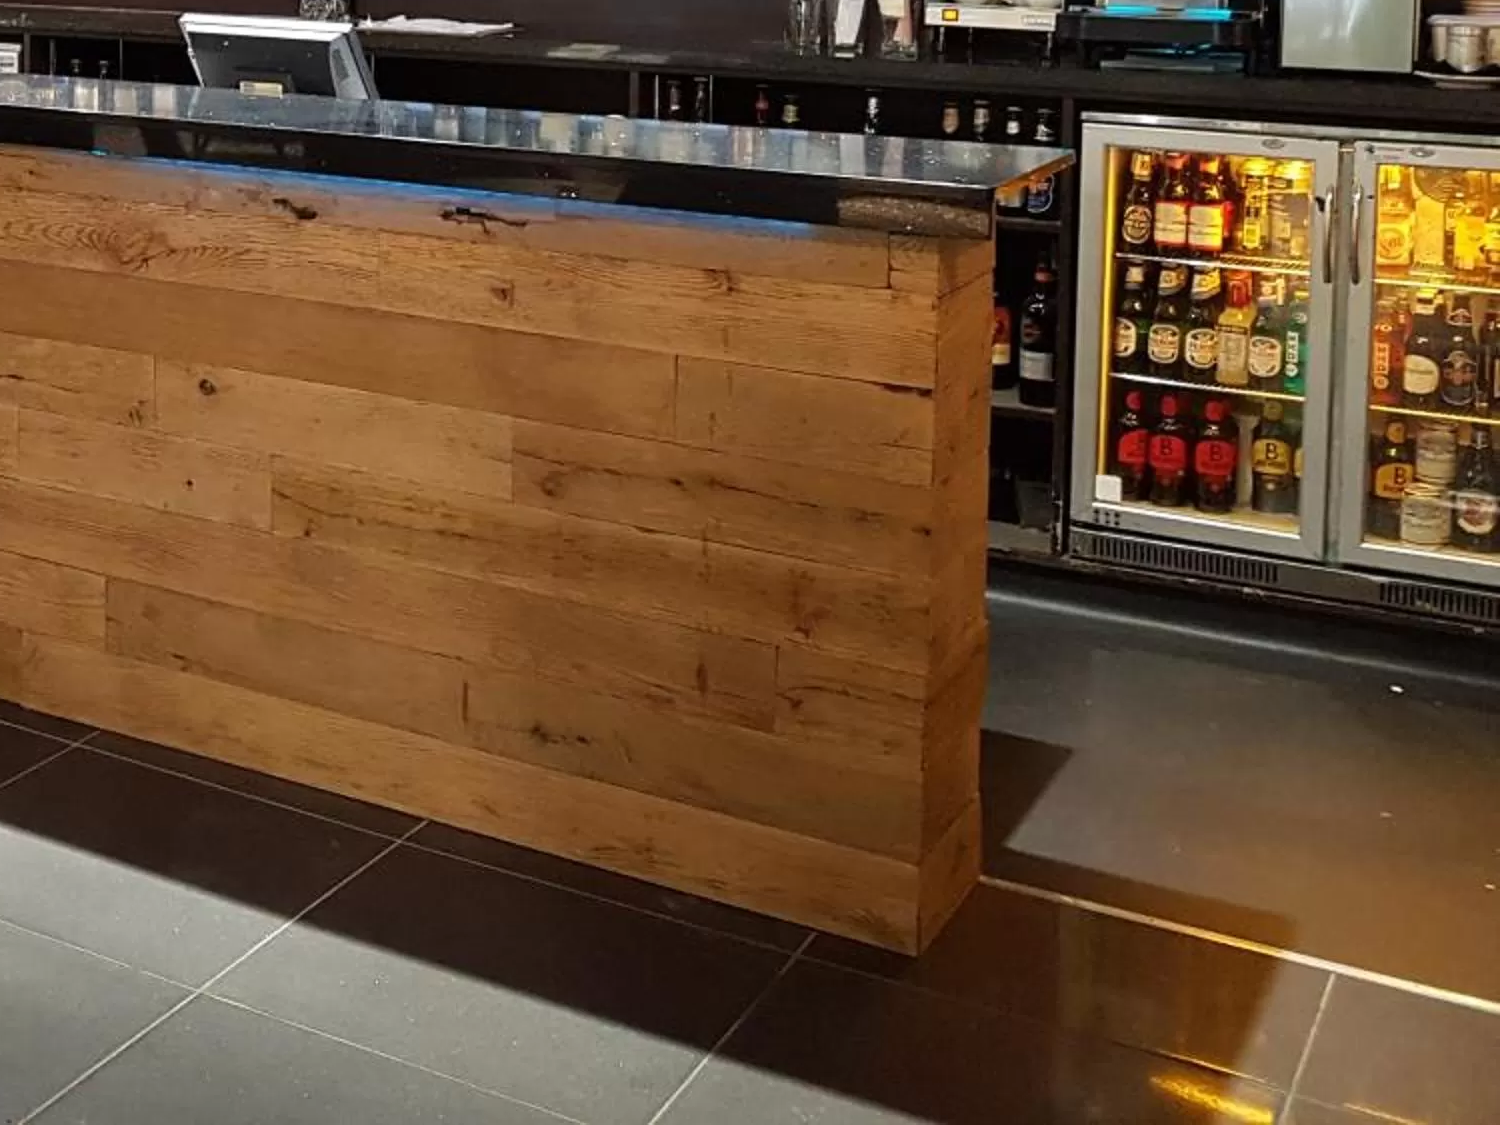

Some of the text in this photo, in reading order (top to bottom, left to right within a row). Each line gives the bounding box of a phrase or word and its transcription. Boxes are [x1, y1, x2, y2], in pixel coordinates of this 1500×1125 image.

[1160, 437, 1174, 456] B
[1209, 442, 1222, 461] B
[1264, 441, 1278, 460] B
[1394, 466, 1405, 485] B
